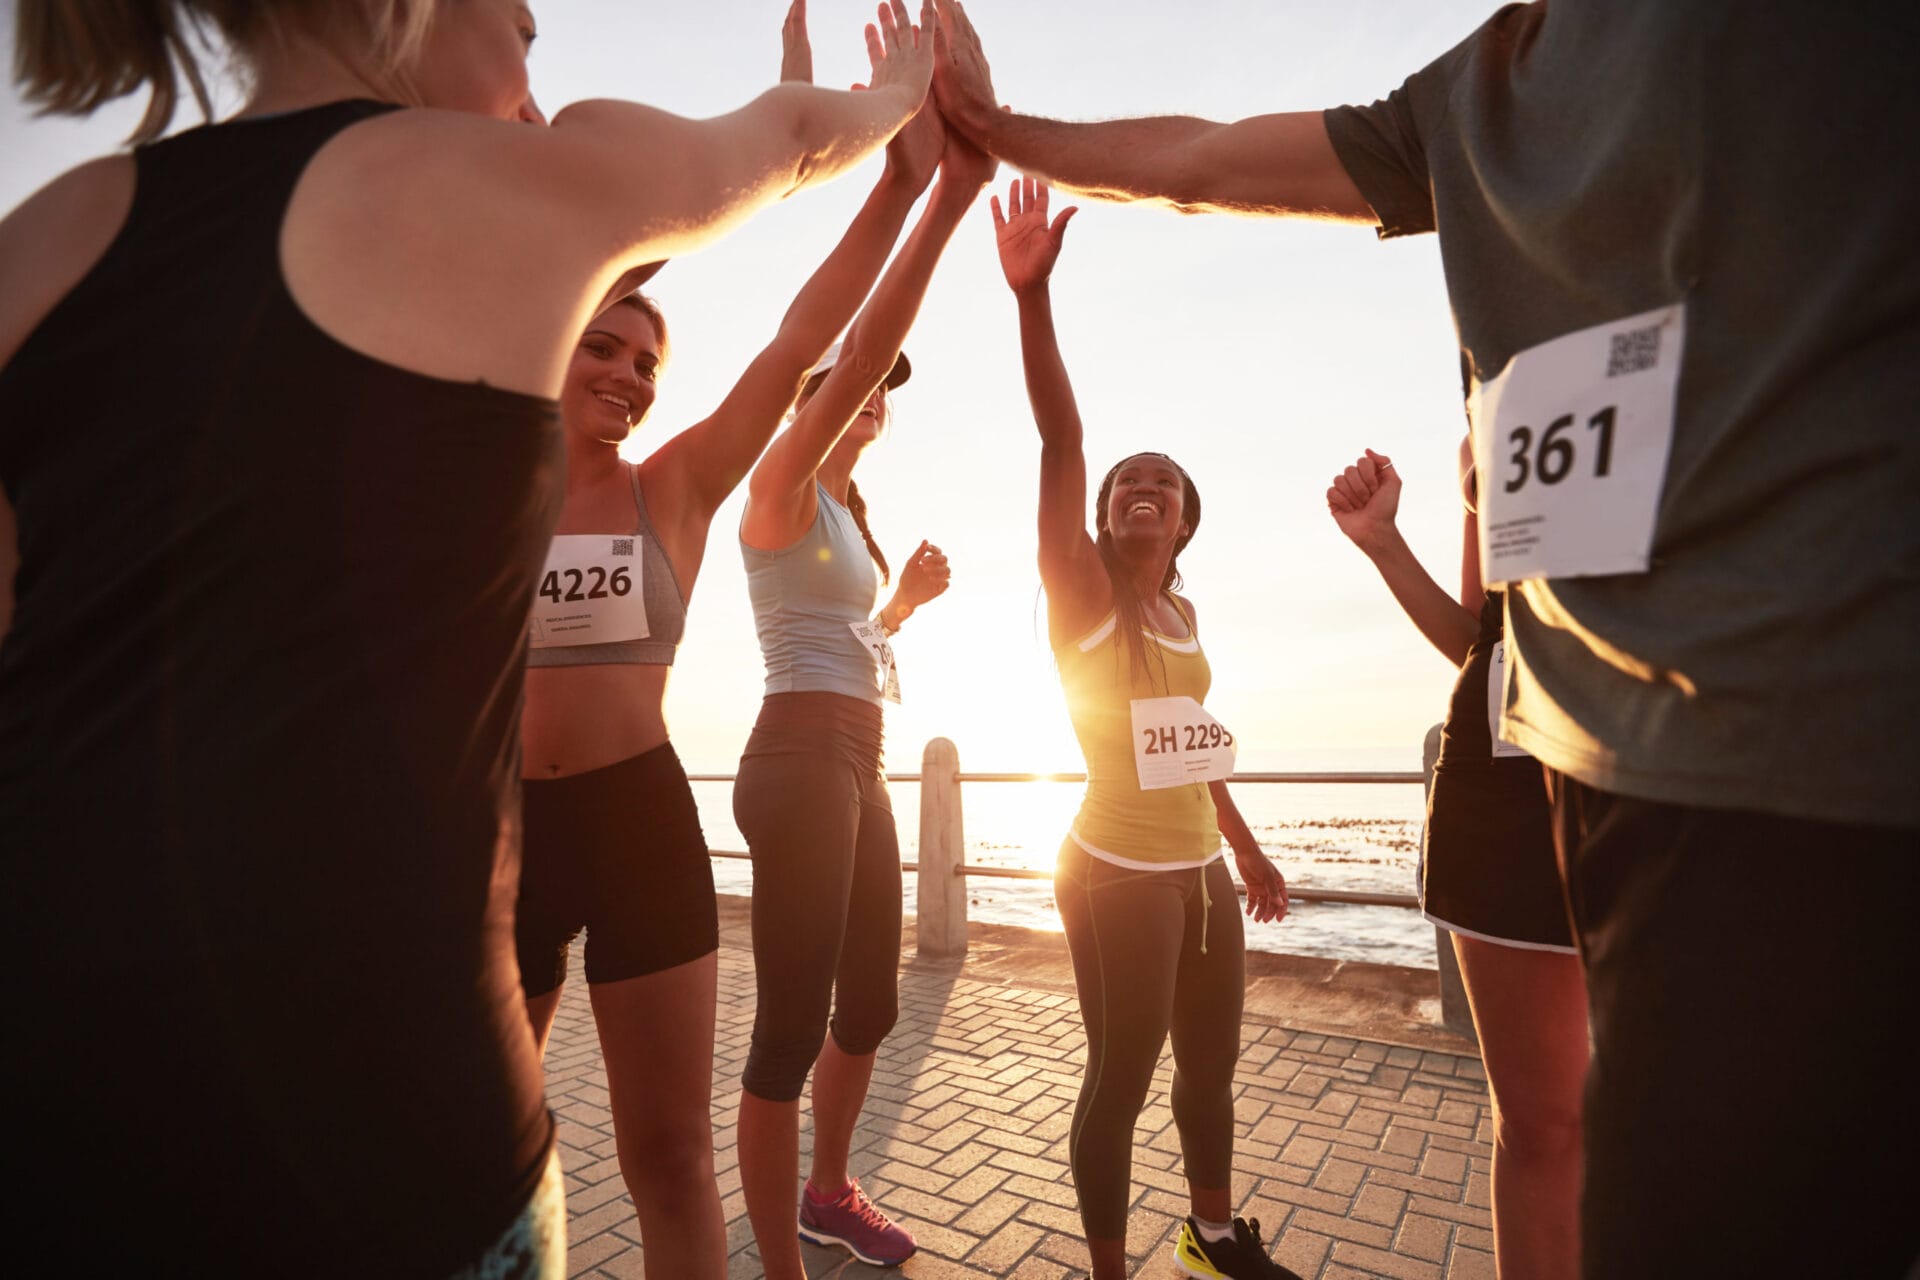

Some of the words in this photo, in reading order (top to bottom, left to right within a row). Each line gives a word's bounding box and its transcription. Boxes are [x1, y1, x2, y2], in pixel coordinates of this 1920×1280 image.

[1505, 405, 1617, 494] 361
[540, 566, 632, 604] 4226
[1143, 726, 1178, 755] 2H
